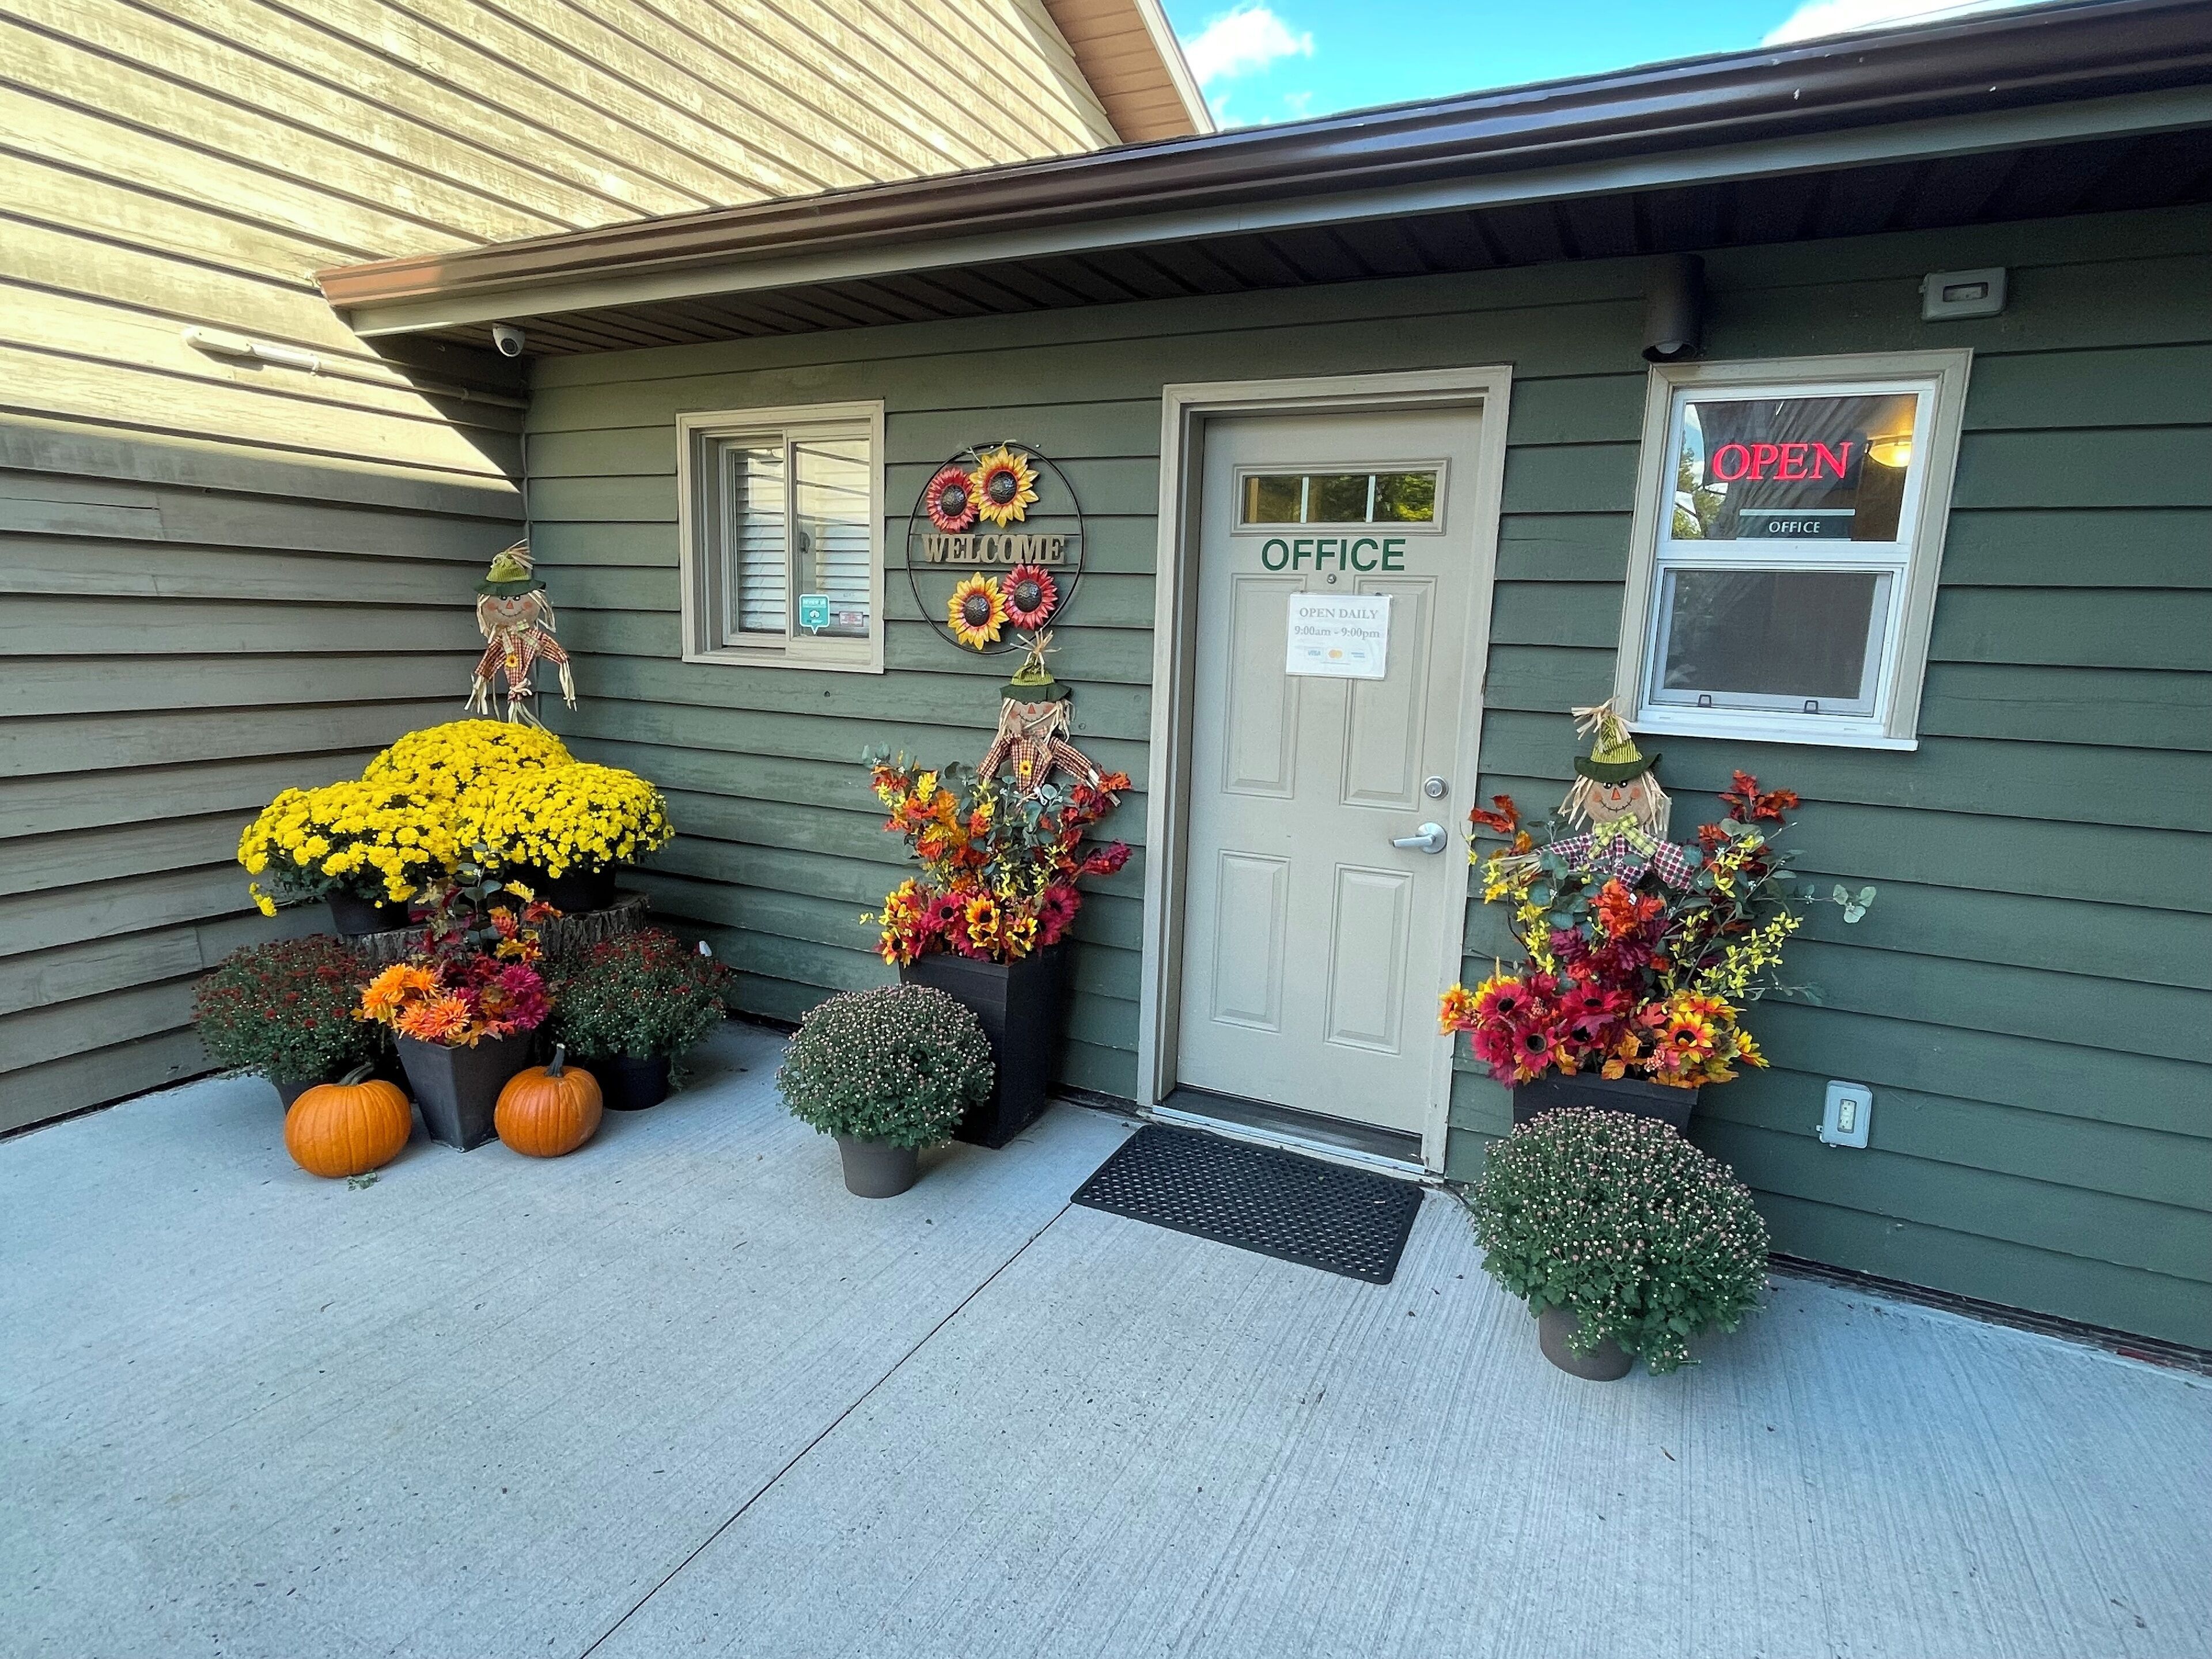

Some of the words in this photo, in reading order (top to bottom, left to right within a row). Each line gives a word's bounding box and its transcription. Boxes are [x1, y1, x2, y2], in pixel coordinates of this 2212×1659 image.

[1713, 442, 1853, 480] OPEN
[1768, 520, 1820, 533] OFFICE
[922, 533, 1065, 564] WELCOME
[1262, 539, 1406, 571] OFFICE
[1300, 607, 1335, 618] OPEN
[1339, 608, 1378, 619] DAILY
[1294, 626, 1331, 636] 9:00am
[1341, 627, 1380, 641] 9:00pm
